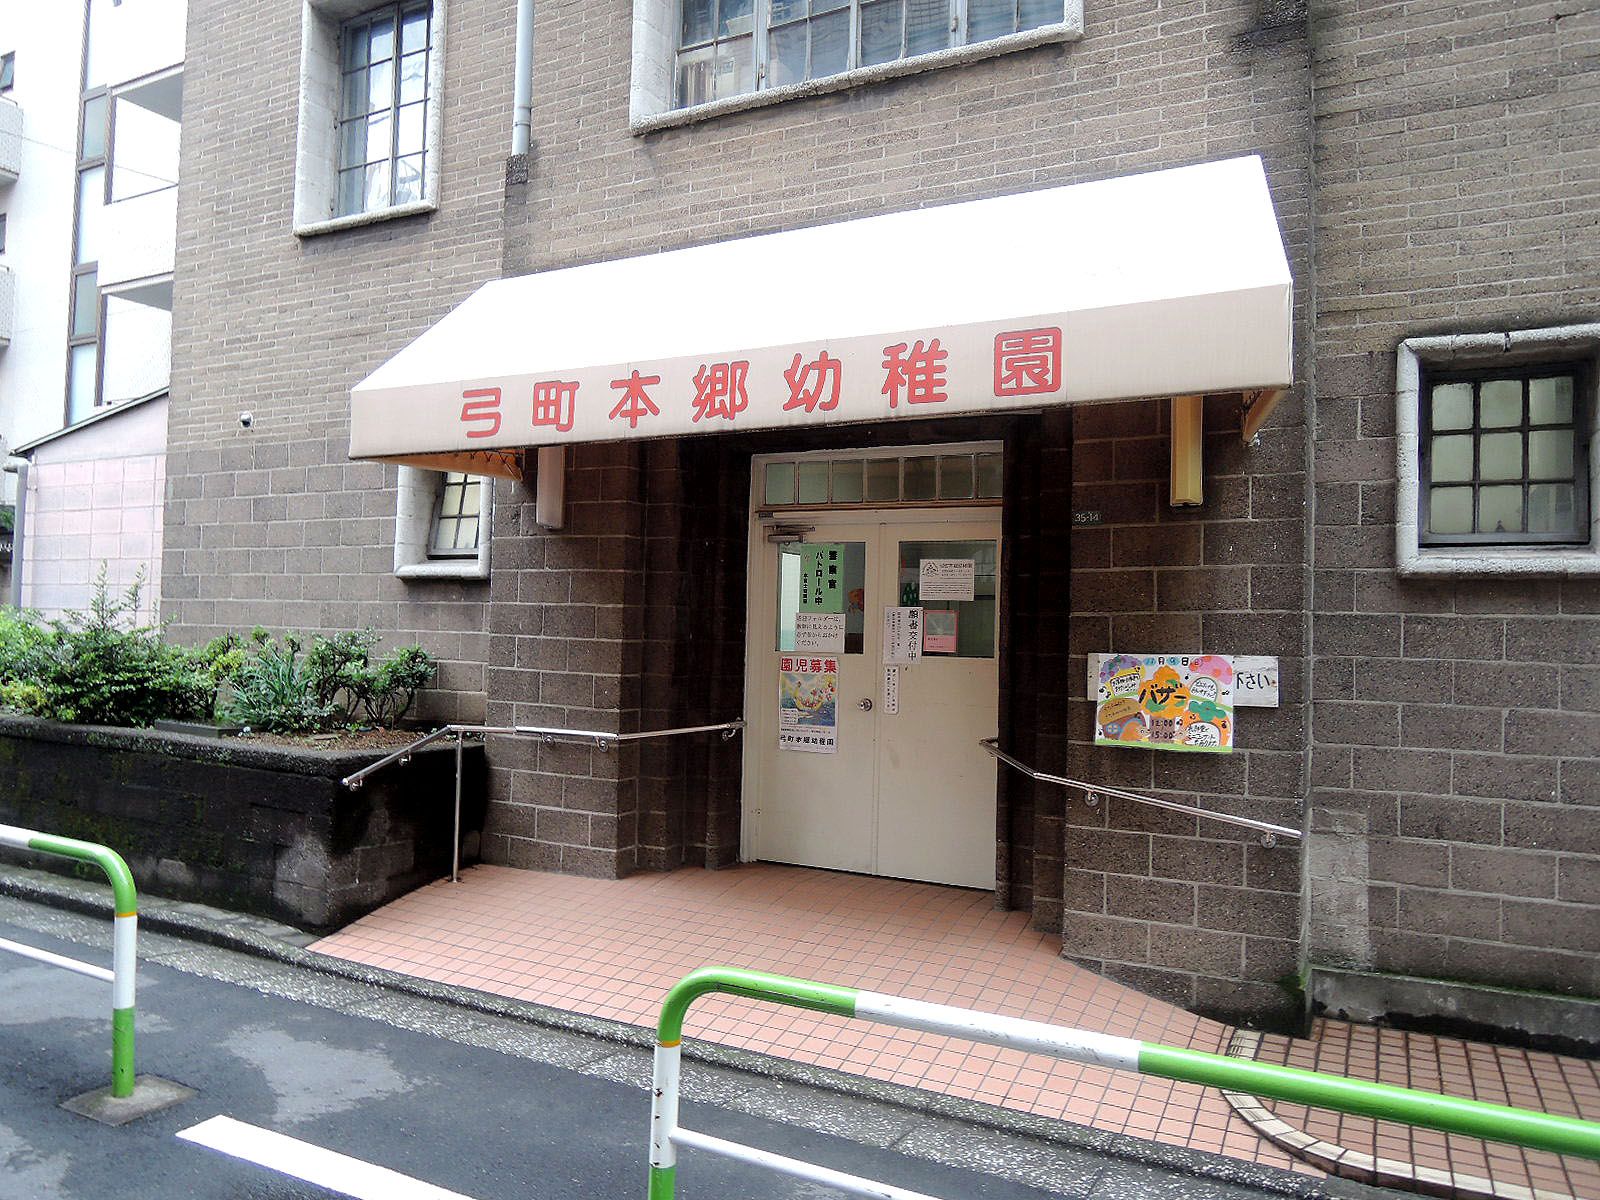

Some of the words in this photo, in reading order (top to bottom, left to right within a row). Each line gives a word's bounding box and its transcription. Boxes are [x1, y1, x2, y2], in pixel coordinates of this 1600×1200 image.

[460, 327, 1063, 438] 弓町本郷幼稚園
[814, 550, 824, 606] パトロール中
[780, 657, 837, 674] 園児募集
[1138, 683, 1187, 705] バザー
